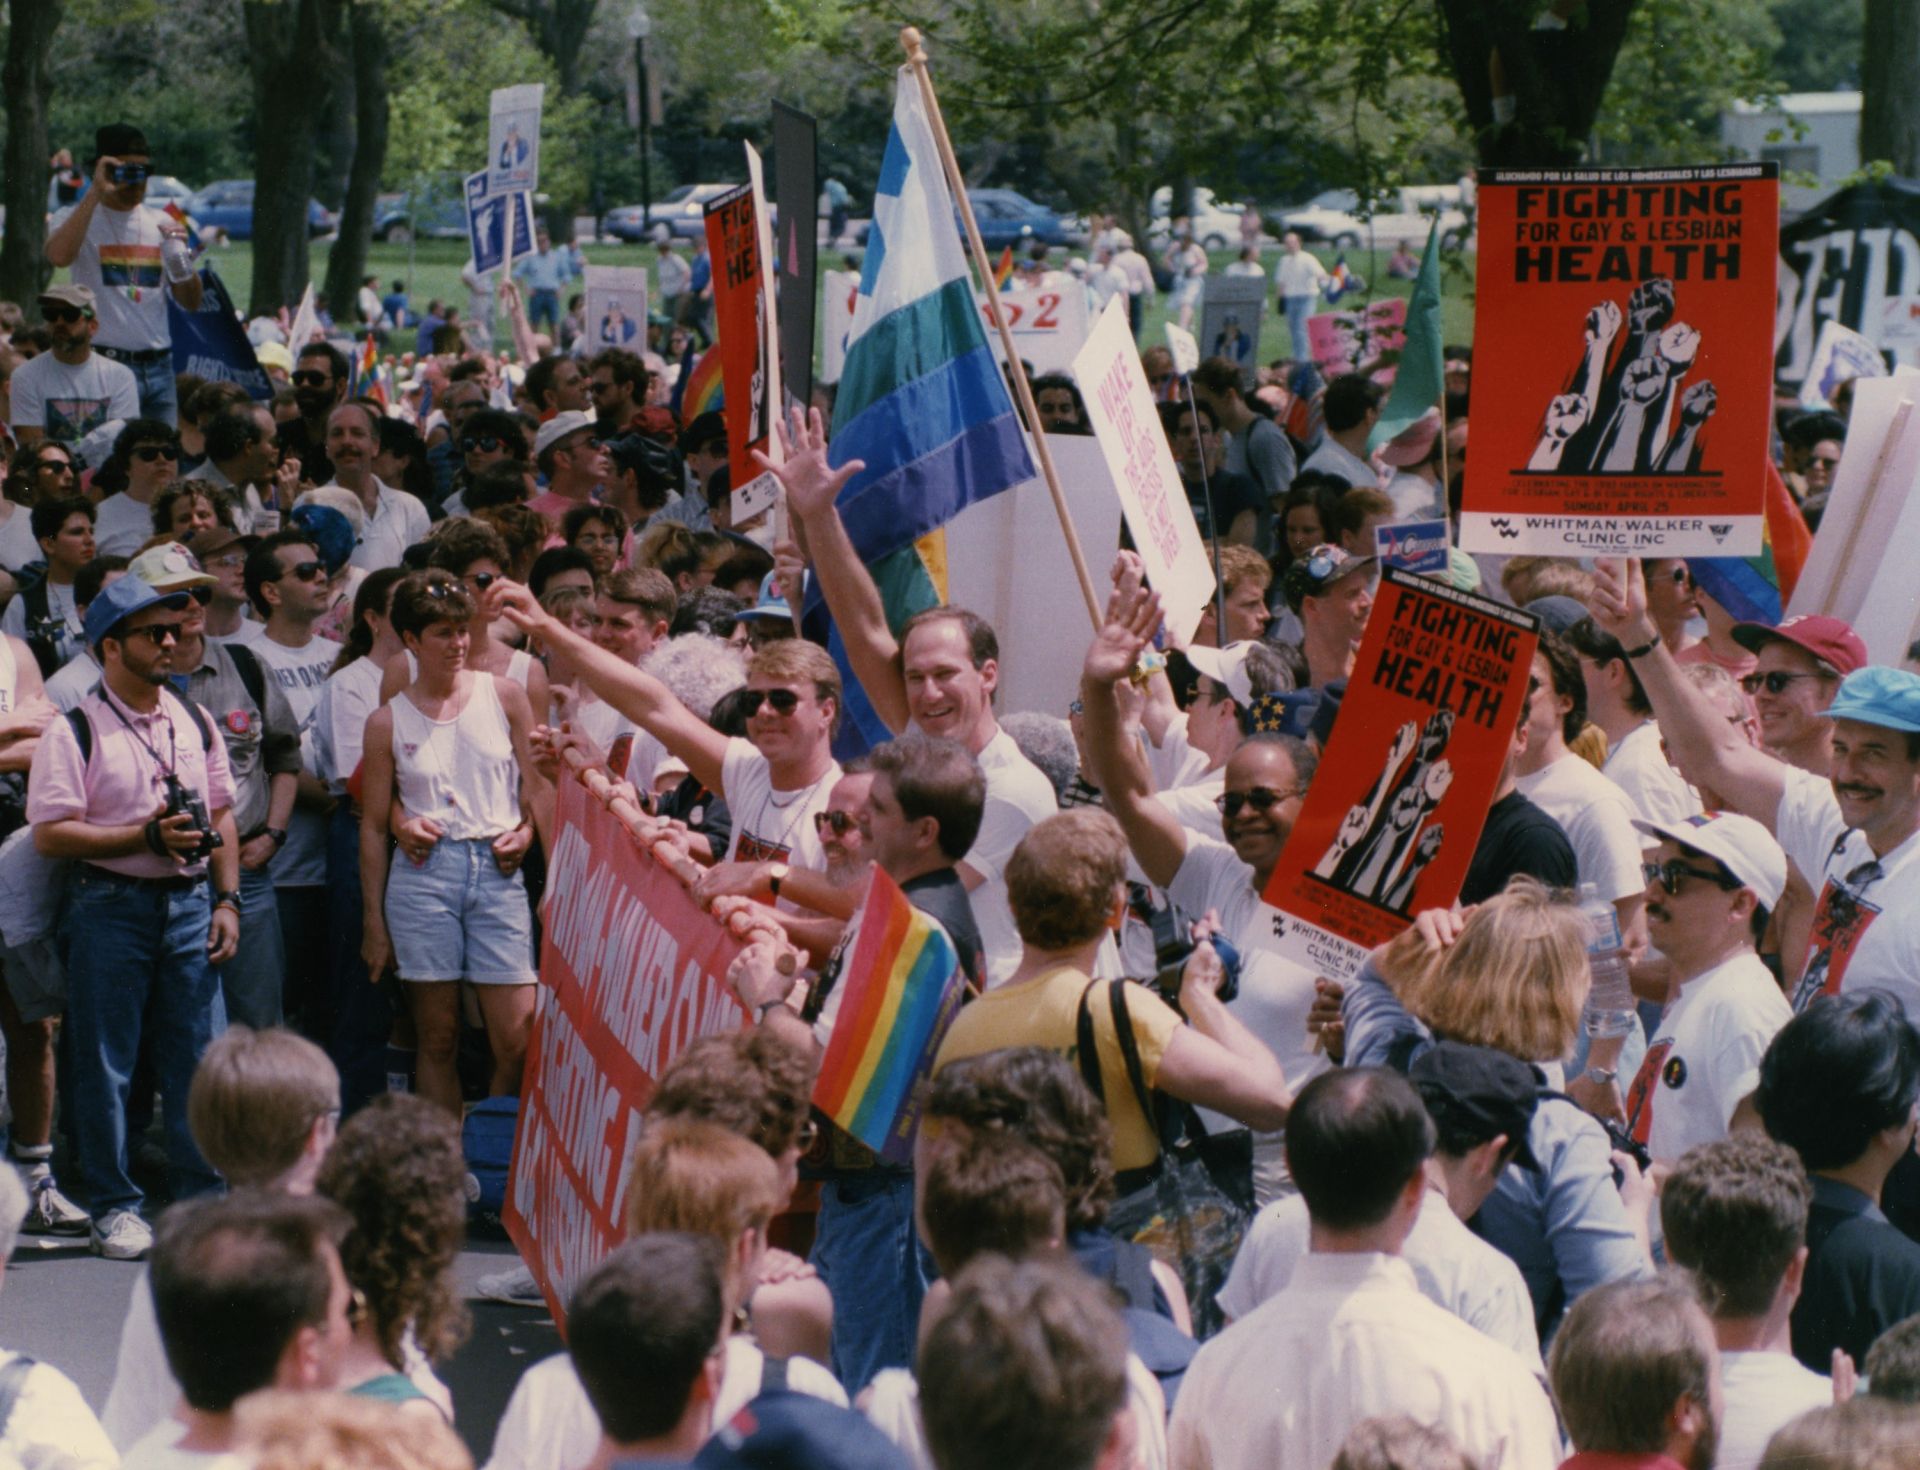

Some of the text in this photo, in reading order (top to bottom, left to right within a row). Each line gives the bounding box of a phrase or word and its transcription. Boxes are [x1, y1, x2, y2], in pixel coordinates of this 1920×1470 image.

[1516, 184, 1741, 218] FIGHTING
[1515, 219, 1741, 242] FOR GAY & LESBIAN
[1515, 244, 1741, 282] HEALTH
[1097, 350, 1133, 426] WAKE
[1562, 532, 1665, 545] CLINIC INC
[1393, 590, 1519, 664] FIGHTING
[1386, 624, 1413, 649] FOR
[1415, 635, 1441, 661] GAY
[1457, 650, 1512, 687] LESBIAN
[1372, 648, 1504, 729] HEALTH
[1306, 943, 1342, 966] CLINIC
